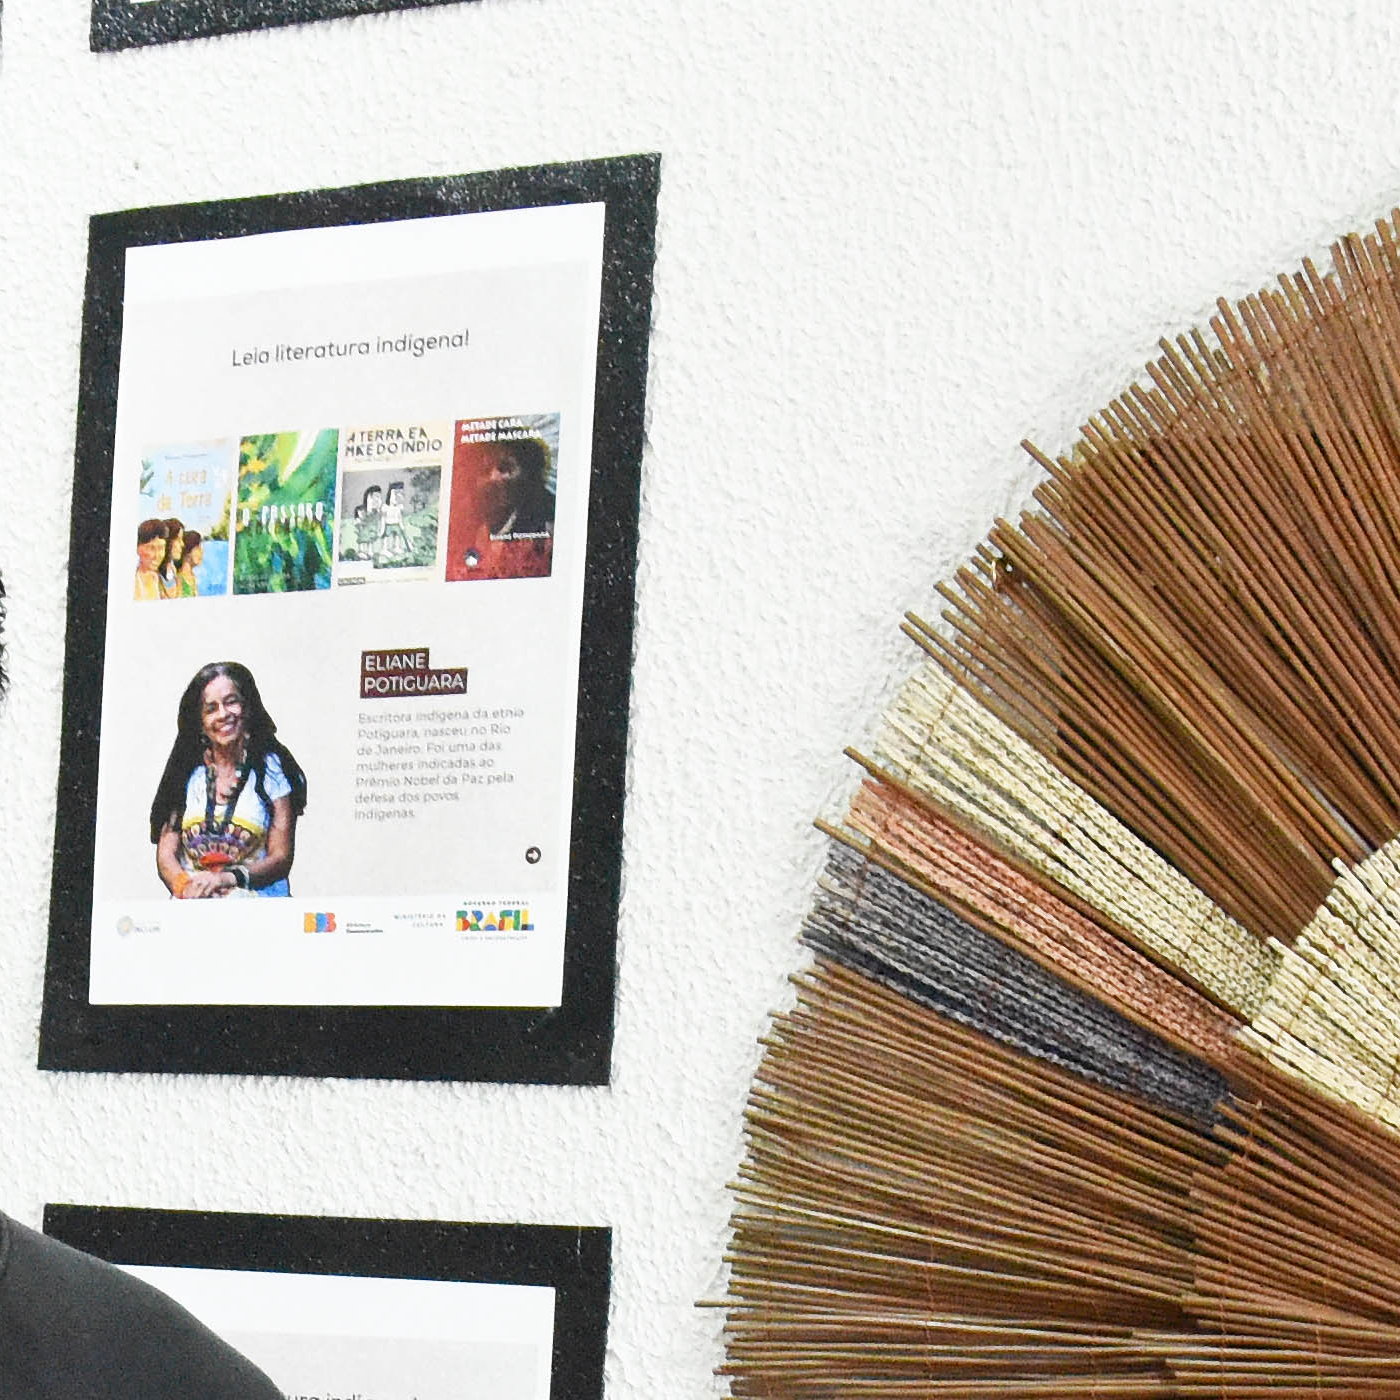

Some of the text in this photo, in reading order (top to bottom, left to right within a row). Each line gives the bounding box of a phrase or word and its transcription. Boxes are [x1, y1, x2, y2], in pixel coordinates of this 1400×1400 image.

[232, 348, 270, 367] Leia
[274, 339, 370, 362] literatura
[359, 428, 404, 441] TERRA
[365, 653, 426, 672] ELIANE
[364, 673, 465, 693] POTIGUARA
[358, 712, 412, 724] Escritora
[472, 709, 489, 719] da
[492, 707, 525, 719] etnia
[423, 727, 468, 738] nasceu
[470, 726, 487, 736] no
[490, 724, 511, 735] Rio
[356, 746, 373, 756] de
[448, 743, 476, 753] uma
[479, 741, 502, 752] das
[356, 760, 414, 772] mulheres
[417, 758, 476, 770] indicadas
[403, 774, 440, 787] Nobel
[442, 774, 458, 785] da
[487, 772, 515, 785] pela
[354, 793, 395, 805] defesa
[398, 792, 420, 803] dos
[456, 909, 535, 931] BRASIL
